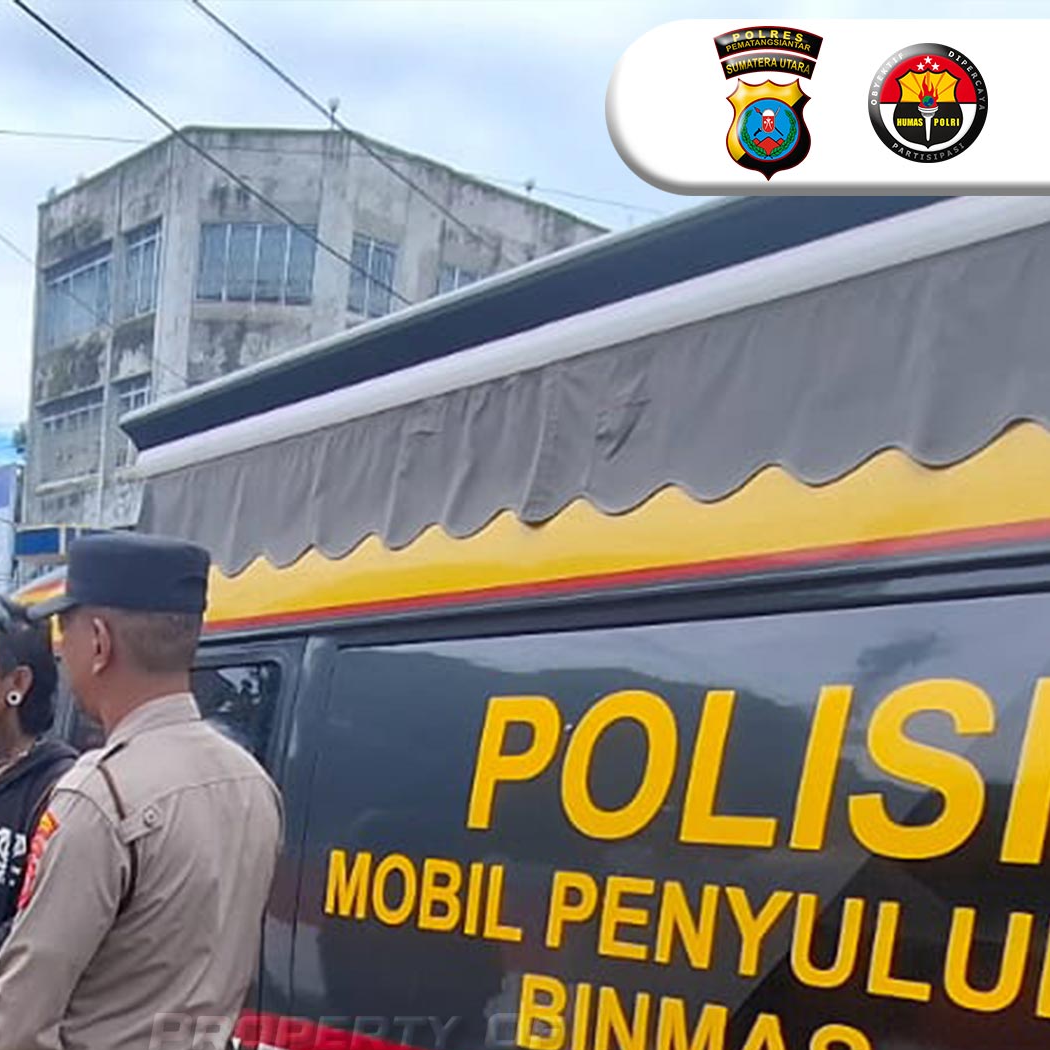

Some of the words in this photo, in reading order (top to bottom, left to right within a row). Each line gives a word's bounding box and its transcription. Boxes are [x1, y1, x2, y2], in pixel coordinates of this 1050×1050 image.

[468, 677, 1050, 864] POLISI
[325, 849, 522, 943] MOBIL
[545, 869, 1050, 1018] PENYULU
